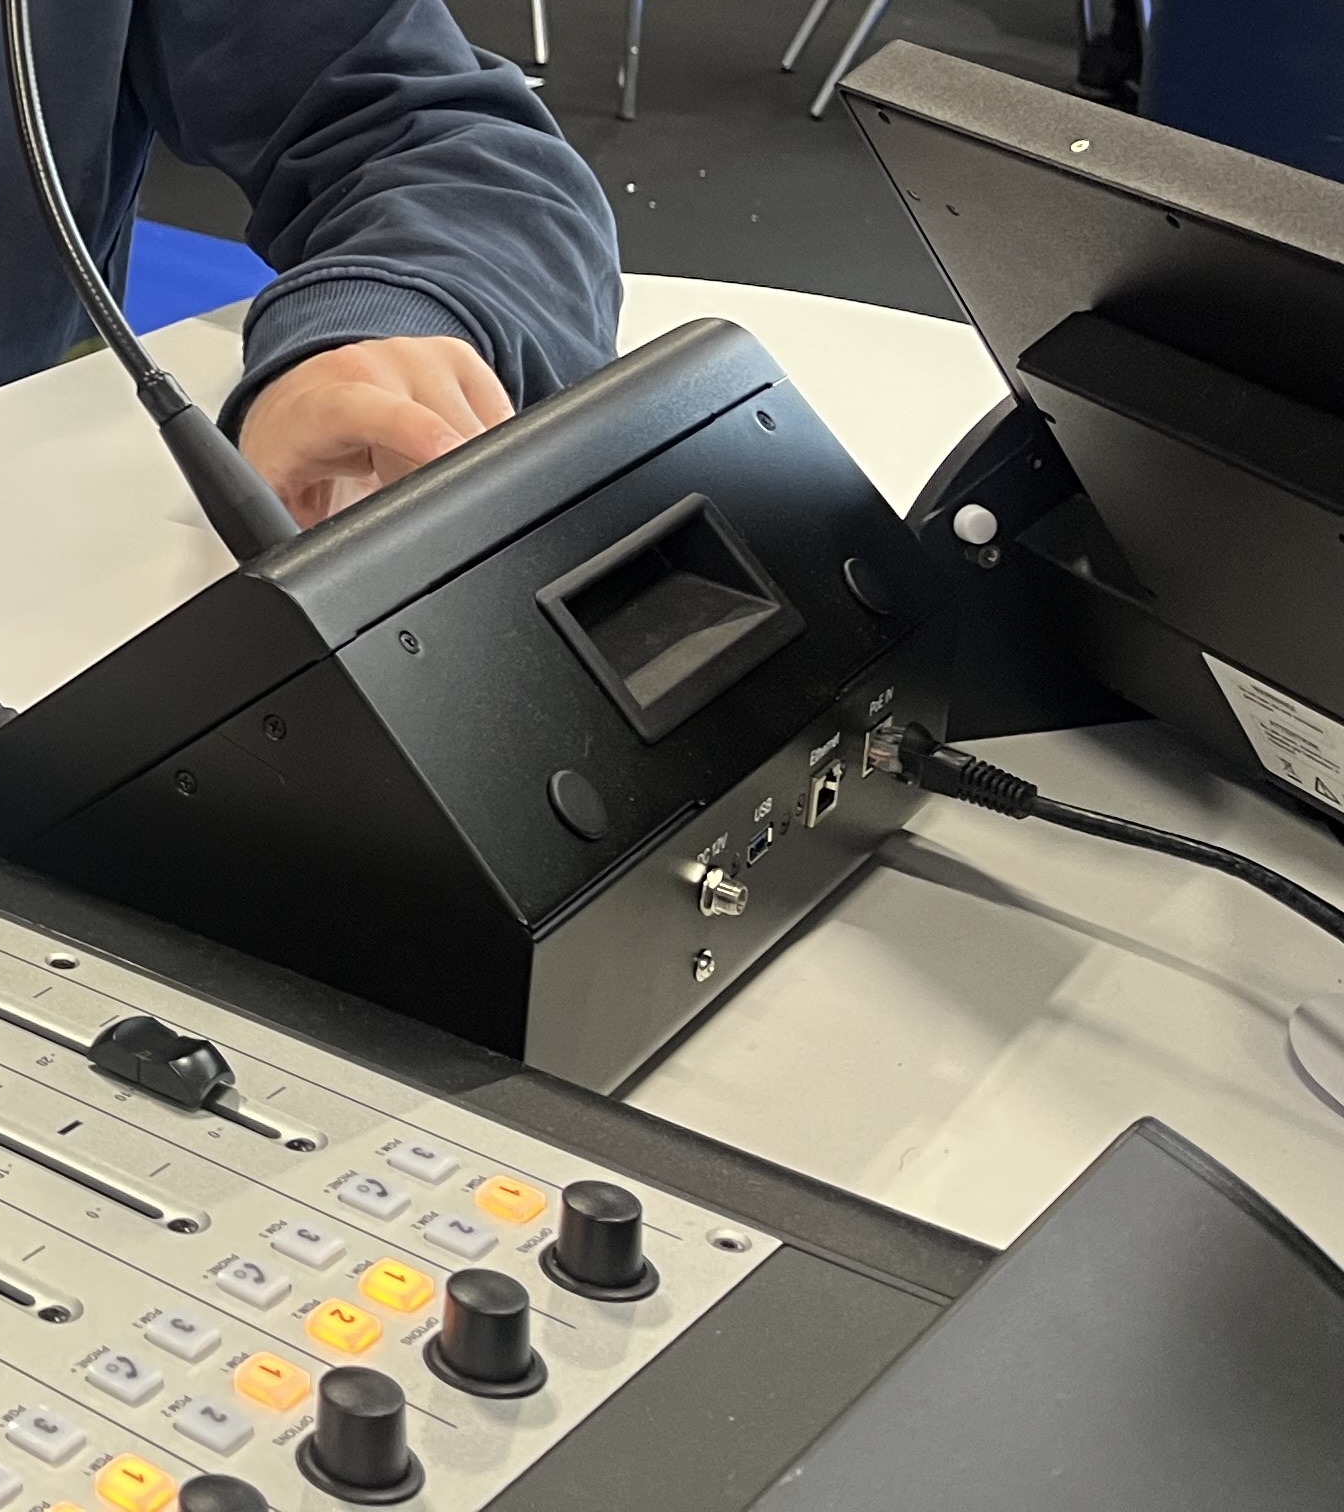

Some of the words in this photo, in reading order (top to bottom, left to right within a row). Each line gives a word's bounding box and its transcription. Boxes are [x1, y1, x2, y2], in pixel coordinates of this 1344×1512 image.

[448, 1220, 474, 1235] 2
[515, 1227, 553, 1253] OPTIONS
[384, 1270, 406, 1284] 1
[329, 1308, 355, 1325] 2
[169, 1318, 195, 1334] 3
[401, 1316, 439, 1345] OPTIONS
[258, 1365, 282, 1379] 1
[201, 1405, 228, 1423] 2
[33, 1417, 59, 1434] 3
[272, 1414, 314, 1446] OPTIONS
[122, 1469, 146, 1484] 1
